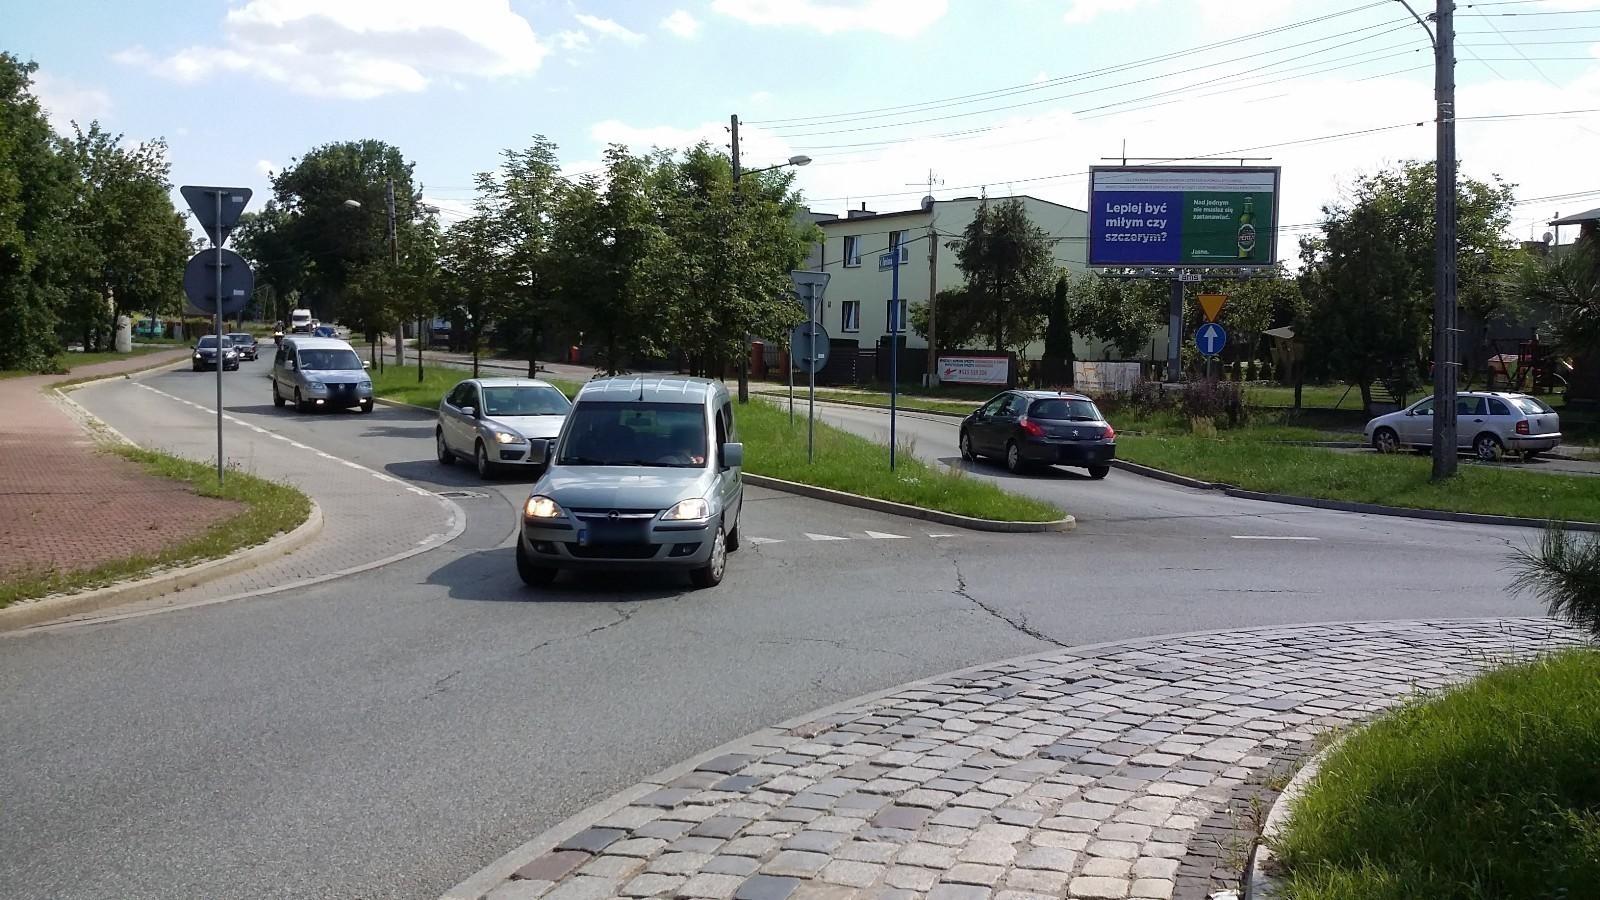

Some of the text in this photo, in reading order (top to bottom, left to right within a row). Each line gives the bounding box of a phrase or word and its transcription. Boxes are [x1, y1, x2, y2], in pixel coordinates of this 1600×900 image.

[1106, 202, 1167, 214] Lepiej być
[1206, 199, 1229, 207] jednym
[1224, 206, 1233, 214] się
[1105, 216, 1167, 229] miłym czy
[1105, 231, 1168, 244] szczerym?
